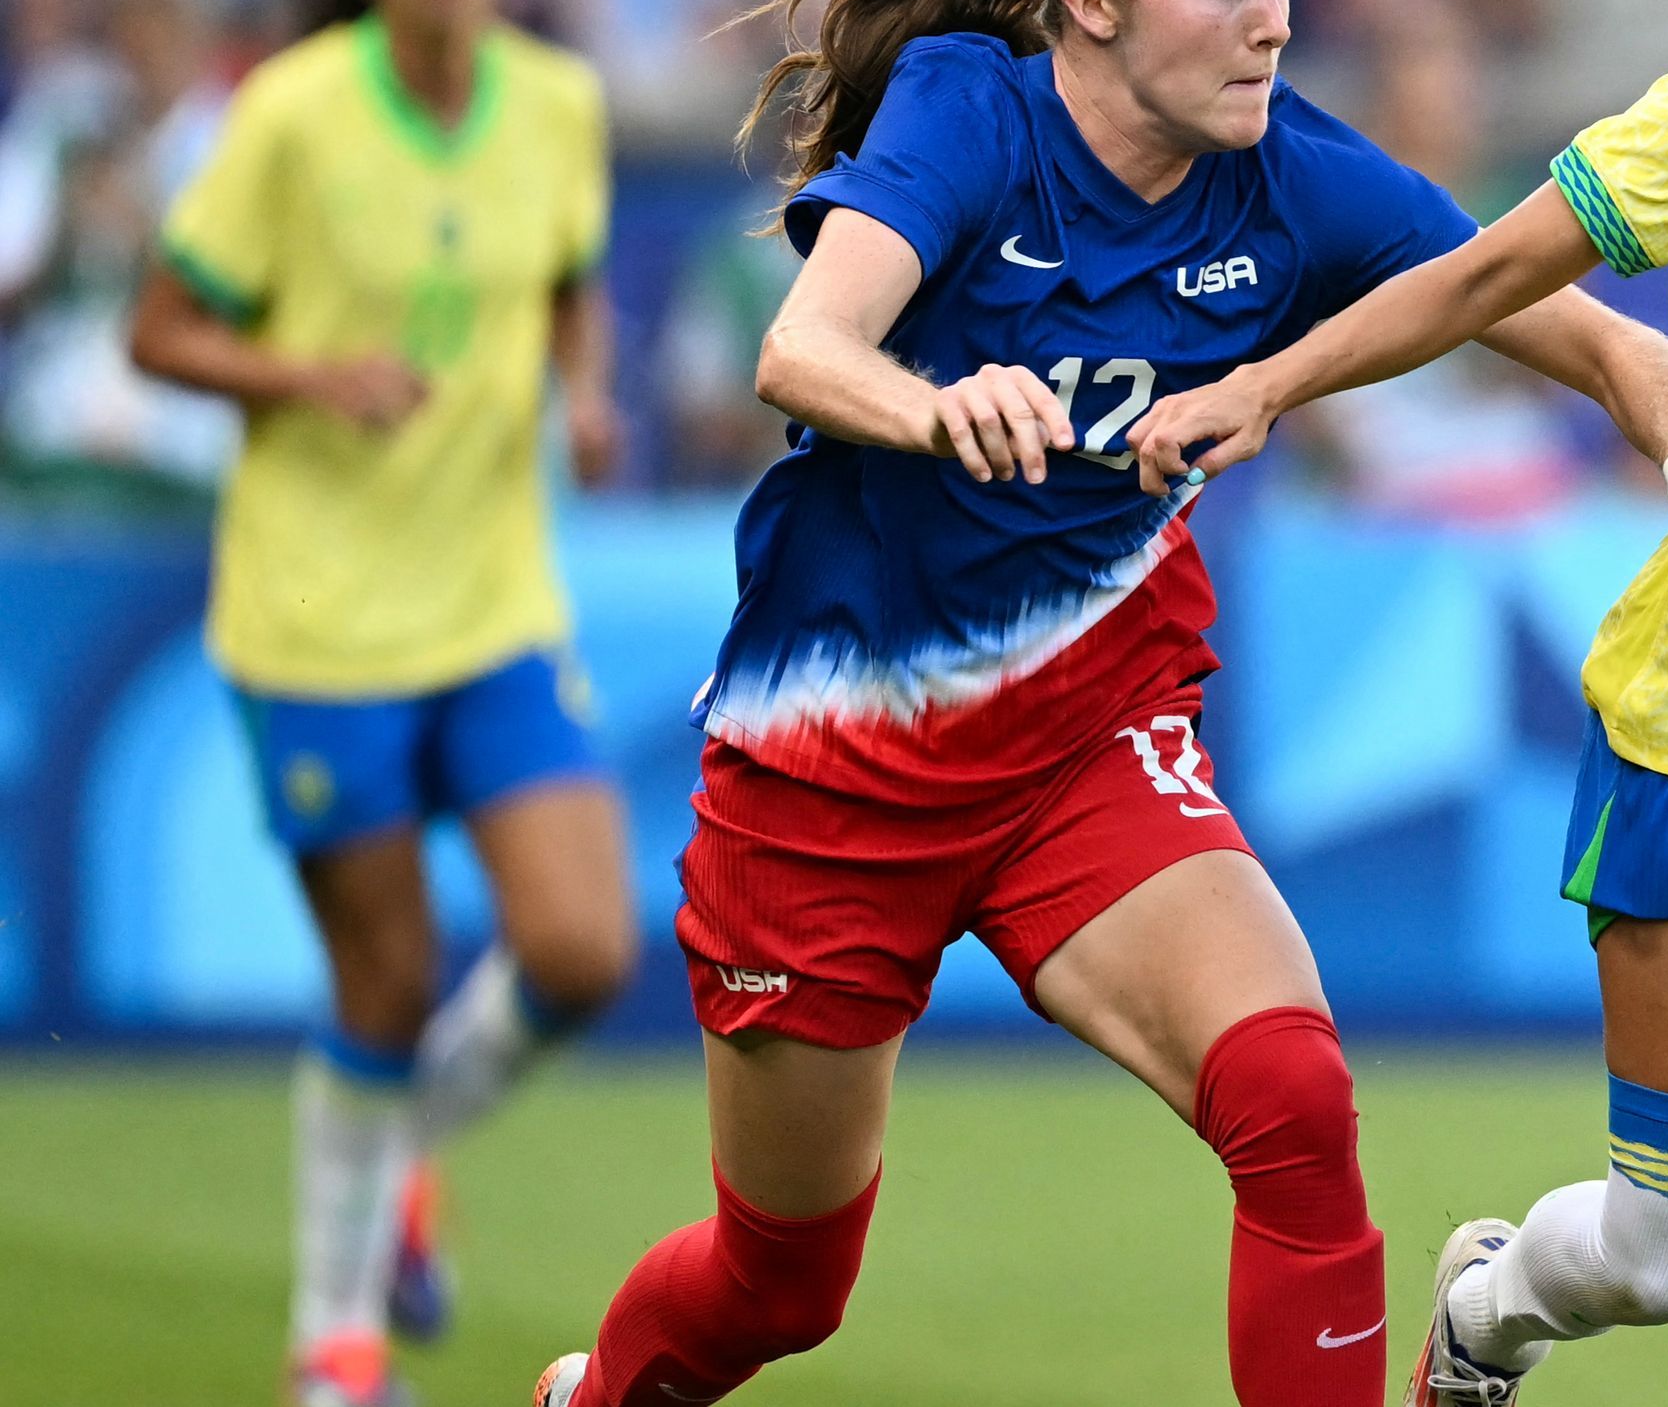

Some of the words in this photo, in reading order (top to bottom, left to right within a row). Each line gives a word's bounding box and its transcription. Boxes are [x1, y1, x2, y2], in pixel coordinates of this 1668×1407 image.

[1176, 255, 1259, 298] USA
[1047, 356, 1157, 471] 12
[1114, 714, 1227, 808] 12
[715, 964, 789, 994] USA
